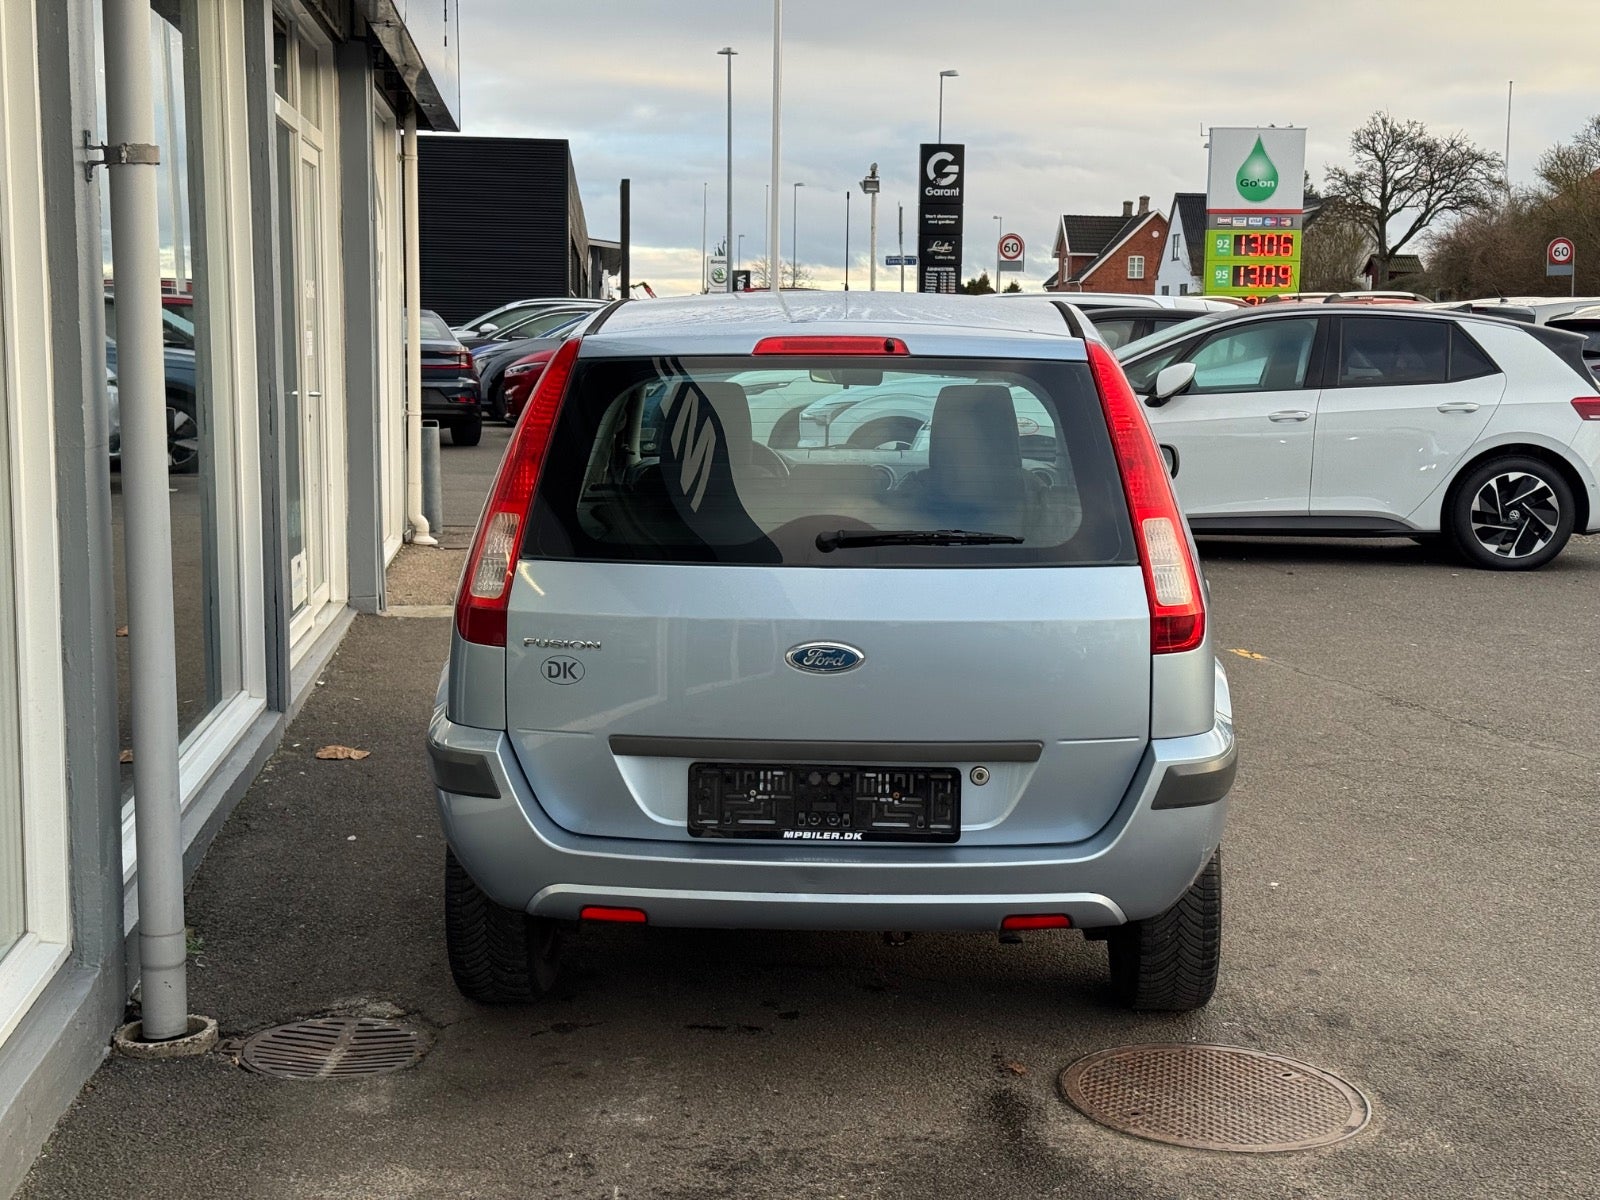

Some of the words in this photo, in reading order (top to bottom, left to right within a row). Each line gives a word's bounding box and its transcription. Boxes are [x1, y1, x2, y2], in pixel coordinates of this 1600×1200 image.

[925, 187, 959, 196] Garant
[1003, 242, 1019, 253] 60
[1217, 239, 1230, 248] 92
[1241, 233, 1293, 257] 13.06
[1553, 246, 1569, 257] 60
[1215, 270, 1228, 279] 95
[1239, 265, 1292, 288] 13.09
[523, 637, 602, 650] FUSION
[803, 648, 847, 666] Ford
[547, 660, 578, 680] DK
[784, 831, 863, 840] MPBILER.DK
